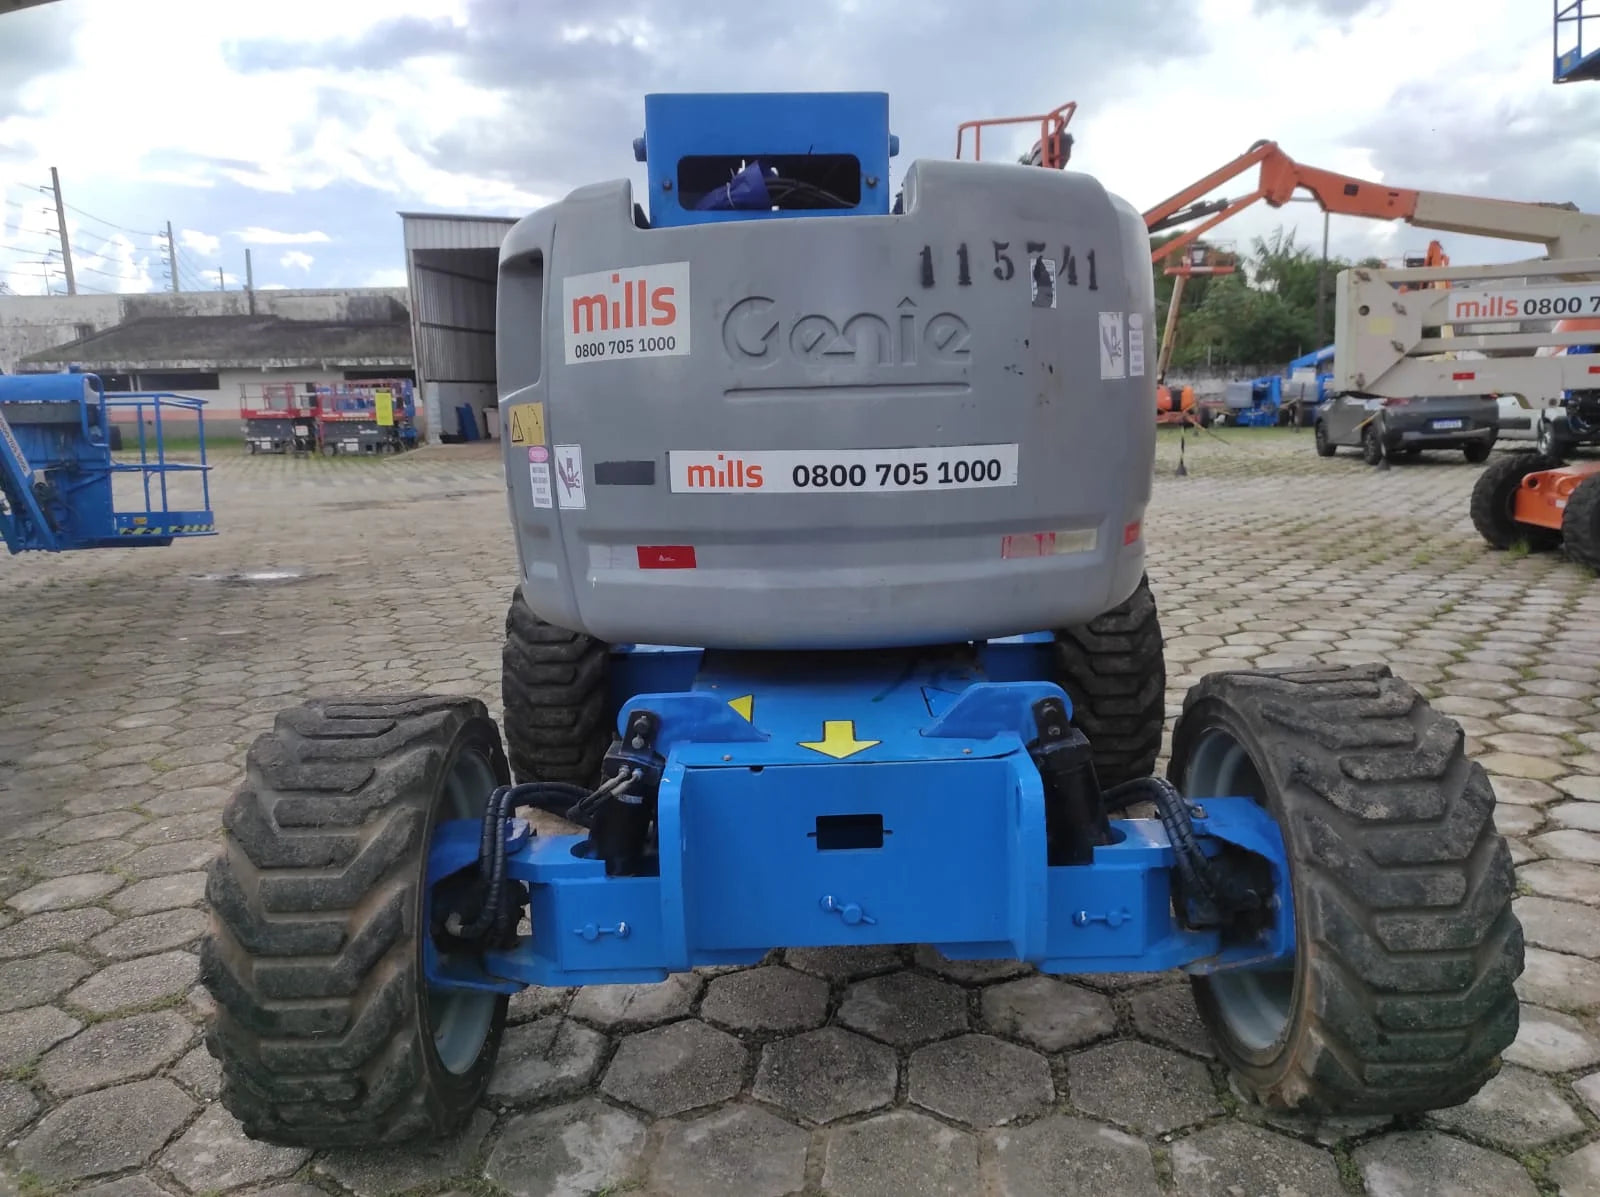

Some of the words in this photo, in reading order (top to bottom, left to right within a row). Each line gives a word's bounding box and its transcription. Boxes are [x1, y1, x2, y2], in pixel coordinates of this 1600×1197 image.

[572, 273, 677, 335] mills
[1455, 294, 1519, 318] mills
[1523, 296, 1583, 316] 0800
[574, 342, 605, 359] 0800
[608, 339, 635, 355] 705
[638, 336, 677, 352] 1000
[721, 296, 973, 370] Genie
[686, 454, 764, 488] mills
[791, 464, 867, 488] 0800
[874, 462, 929, 486] 705
[936, 459, 1003, 484] 1000
